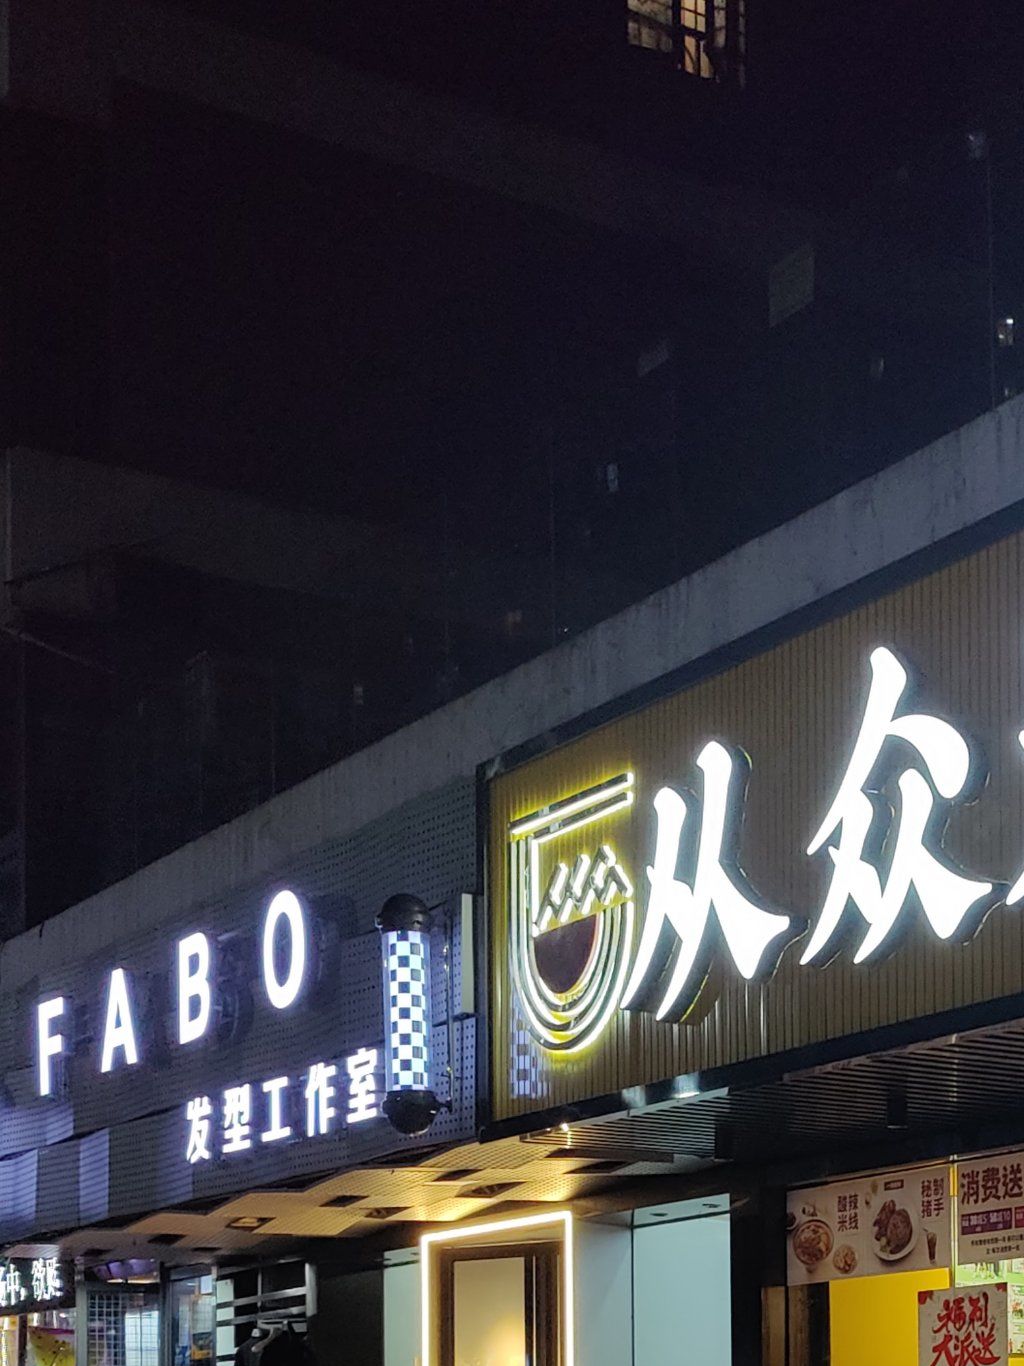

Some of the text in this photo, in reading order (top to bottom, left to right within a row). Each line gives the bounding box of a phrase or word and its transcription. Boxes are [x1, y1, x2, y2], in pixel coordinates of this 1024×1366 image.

[37, 889, 306, 1097] FABO
[185, 1047, 383, 1164] 发型工作室
[837, 1193, 859, 1212] 酸辣
[921, 1198, 945, 1219] 猪手
[837, 1212, 859, 1232] 米线
[932, 1291, 989, 1334] 福利
